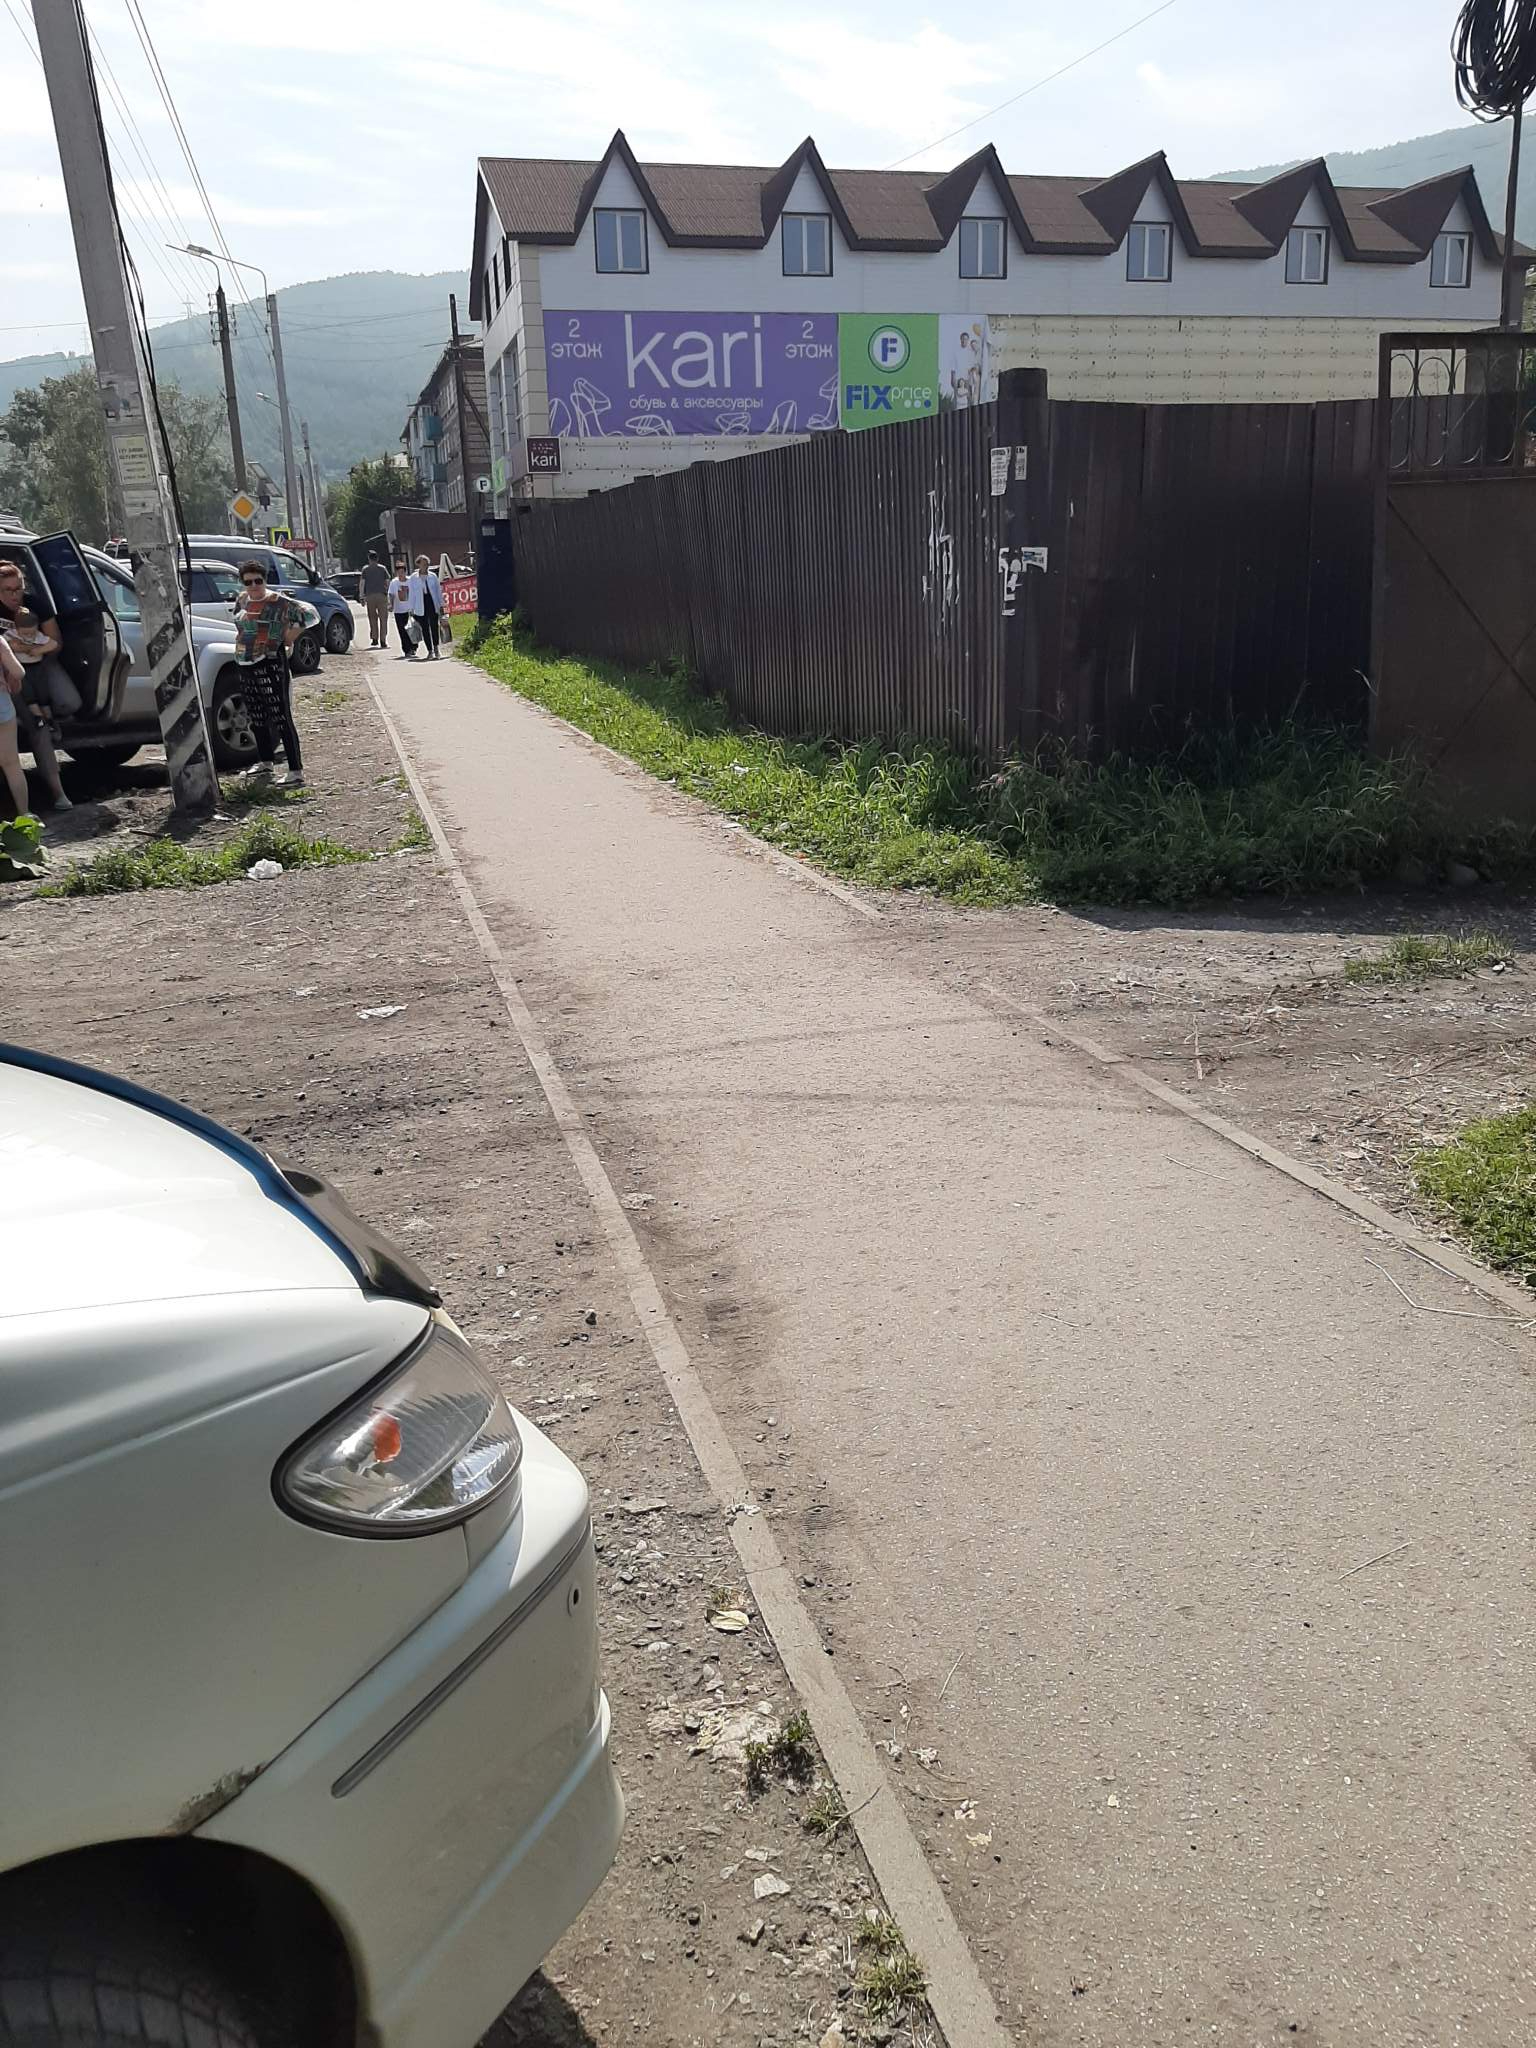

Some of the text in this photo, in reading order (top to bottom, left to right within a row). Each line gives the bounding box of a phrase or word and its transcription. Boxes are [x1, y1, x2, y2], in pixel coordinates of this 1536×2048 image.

[568, 318, 581, 338] 2
[801, 319, 815, 340] 2
[551, 342, 603, 359] этаж
[624, 313, 763, 388] kari
[784, 343, 833, 359] этаж
[881, 337, 898, 363] F
[629, 394, 764, 412] обувь & аксессуары
[530, 451, 558, 467] kari
